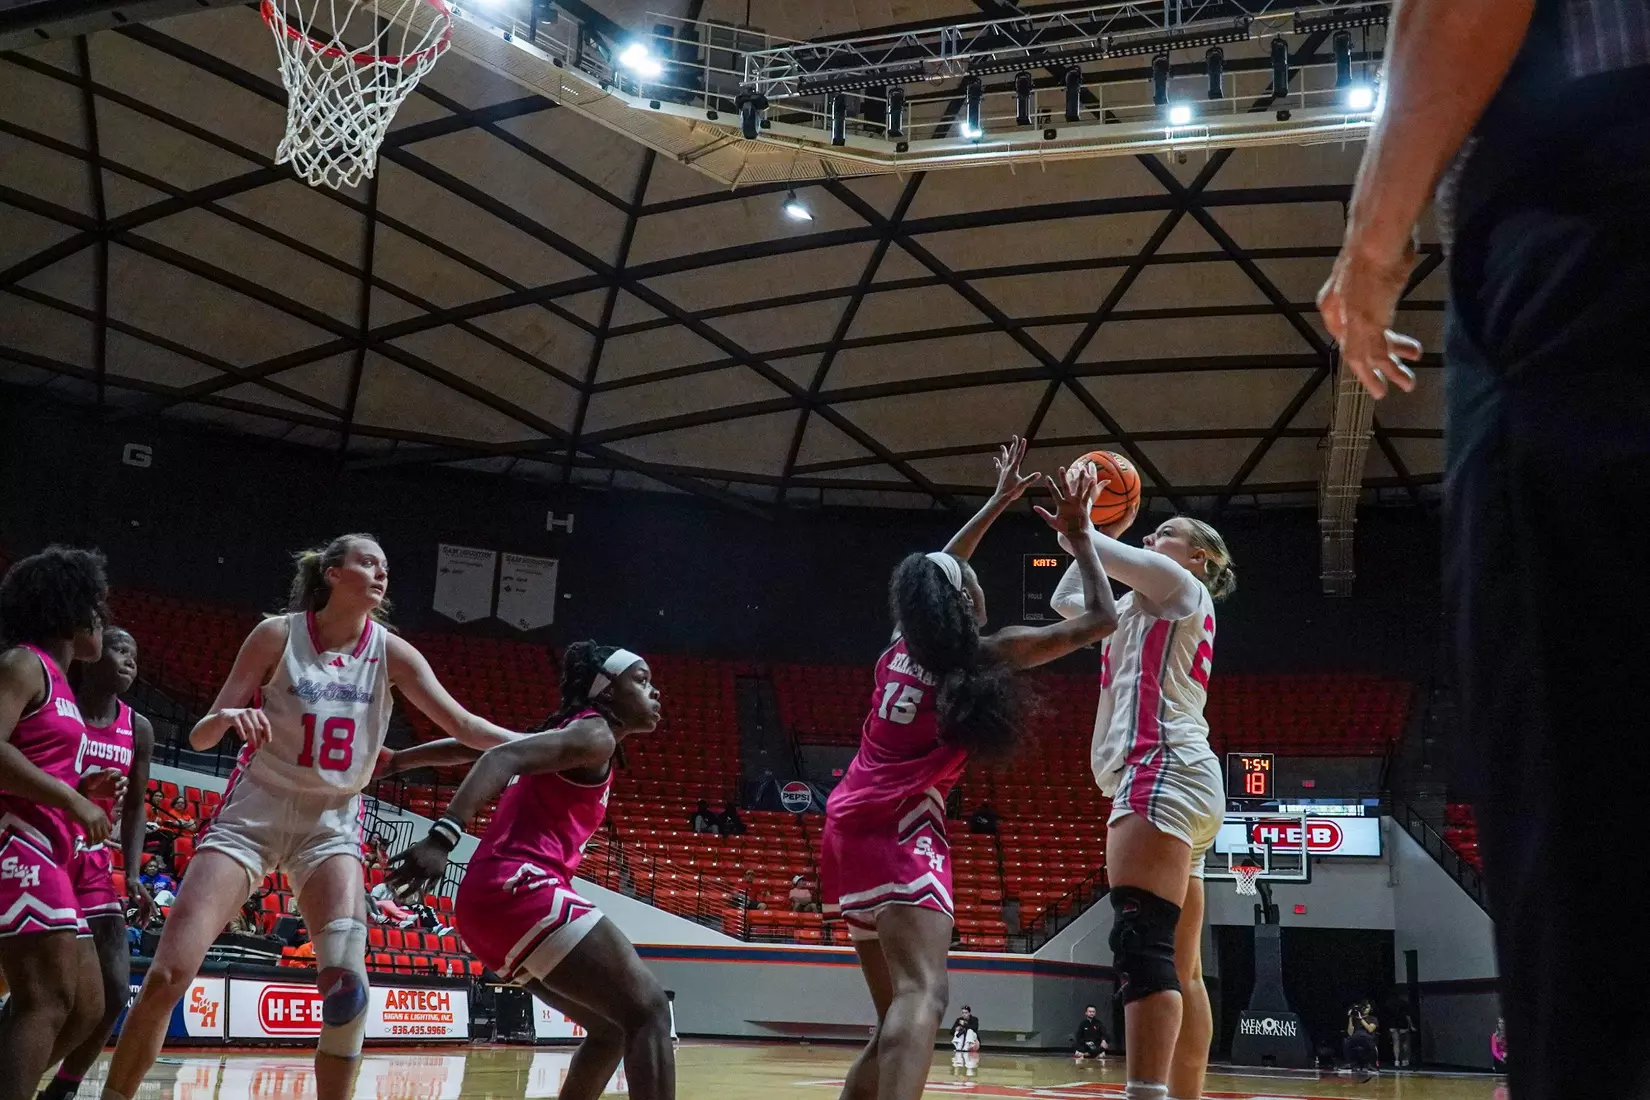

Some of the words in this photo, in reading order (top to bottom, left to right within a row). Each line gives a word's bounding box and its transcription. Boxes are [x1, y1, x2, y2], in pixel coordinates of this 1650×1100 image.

[122, 442, 153, 468] G
[546, 511, 575, 534] H
[1033, 559, 1057, 567] KATS
[878, 681, 924, 725] 15
[297, 712, 356, 772] 18
[1242, 758, 1269, 770] 7:54
[1246, 772, 1265, 795] 18
[783, 792, 810, 801] PEPSI
[385, 989, 450, 1011] ARTECH
[383, 1012, 404, 1020] SIGNS
[391, 1025, 447, 1035] 936.435.9966
[1240, 1017, 1297, 1031] MEMORIAL
[1240, 1025, 1297, 1037] HERMANN
